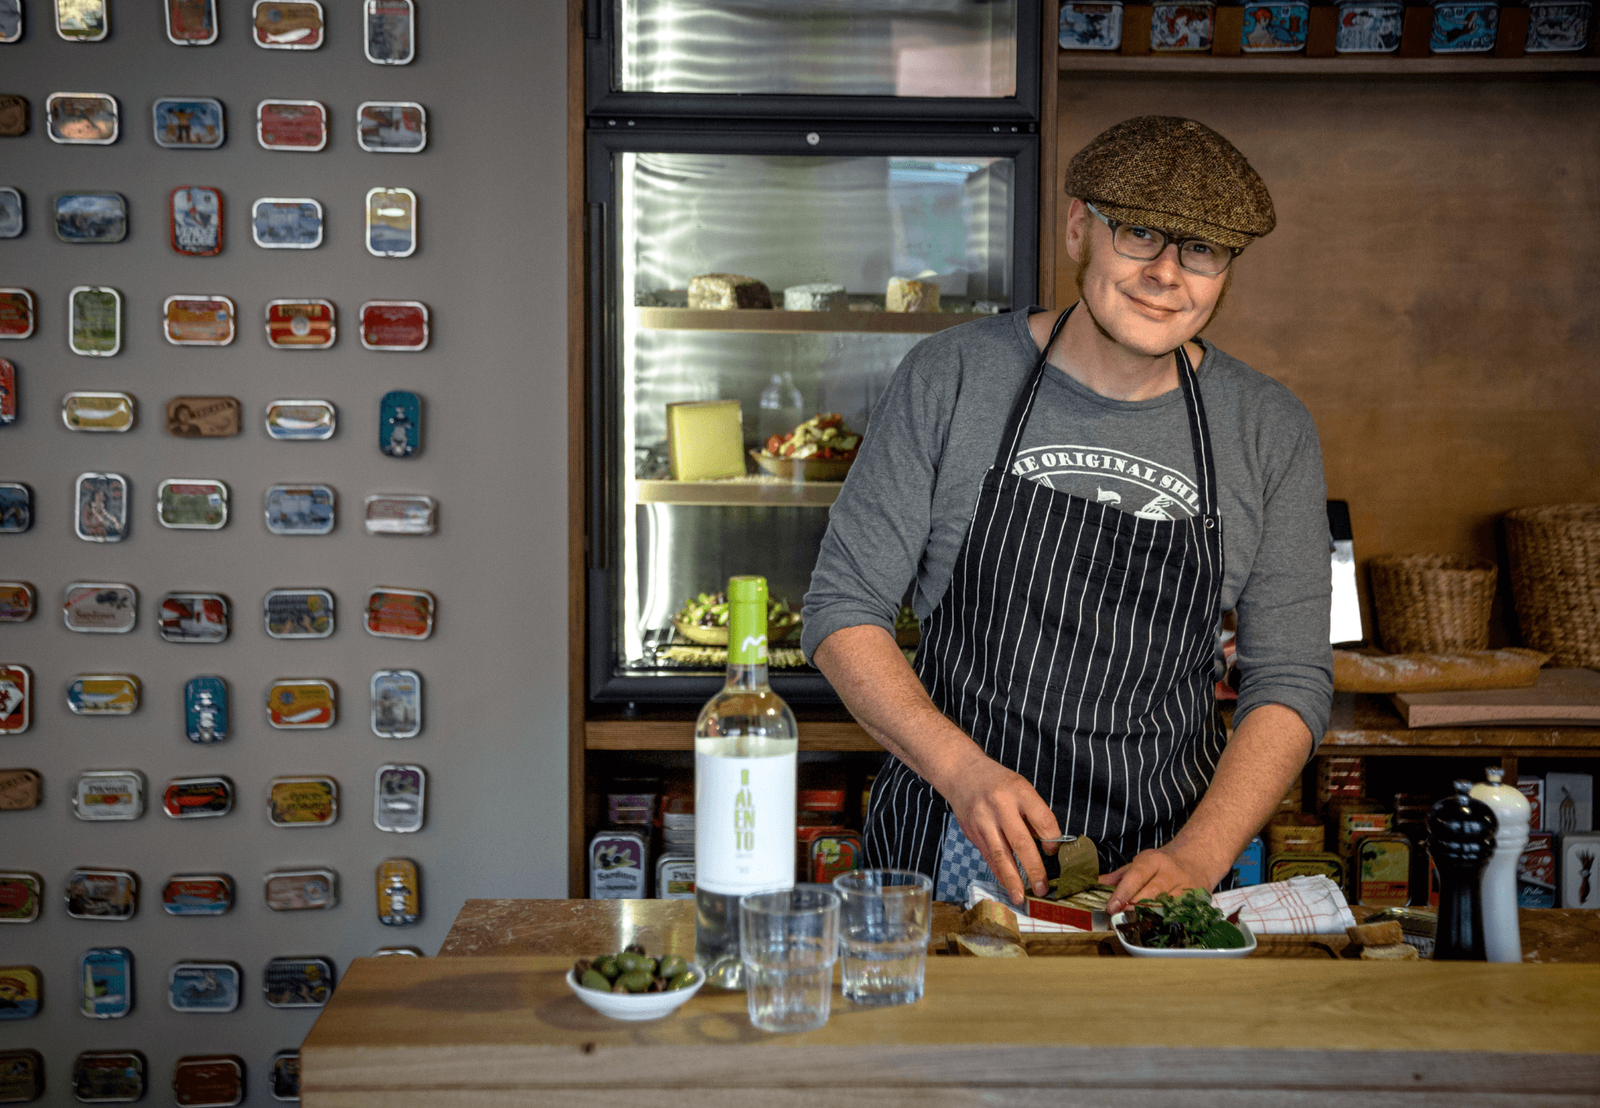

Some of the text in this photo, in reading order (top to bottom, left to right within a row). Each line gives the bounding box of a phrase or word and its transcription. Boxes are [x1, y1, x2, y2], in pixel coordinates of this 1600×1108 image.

[1011, 452, 1199, 510] HE ORIGINAL SHI
